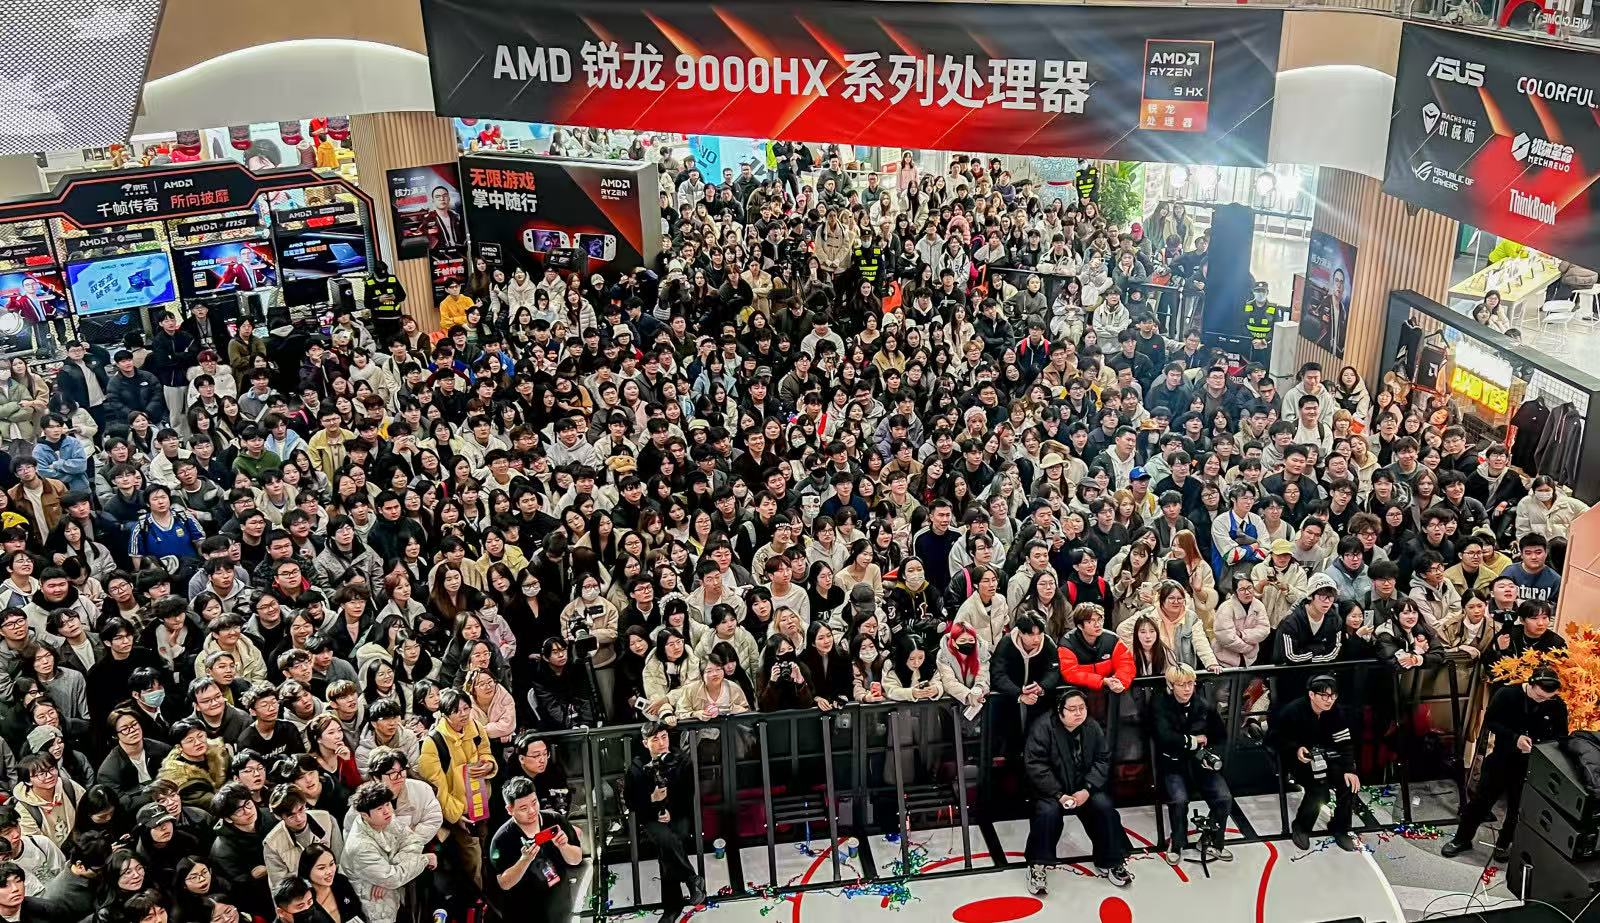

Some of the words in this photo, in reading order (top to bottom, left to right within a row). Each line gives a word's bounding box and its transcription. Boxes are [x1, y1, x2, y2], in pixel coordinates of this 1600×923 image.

[1151, 52, 1186, 65] AMD
[493, 44, 572, 83] AMD
[580, 39, 666, 93] 锐龙
[675, 54, 829, 98] 9000HX
[841, 51, 1091, 115] 系列处理器
[1150, 67, 1193, 77] RYZEN
[1427, 56, 1486, 87] ASUS
[1174, 86, 1183, 96] 9
[1185, 87, 1203, 97] HX
[1439, 120, 1476, 143] 机械师
[1530, 137, 1575, 163] 机械革命
[469, 168, 536, 190] 无限游戏
[600, 178, 622, 188] AMD
[1432, 176, 1459, 191] GAMERS
[1434, 167, 1464, 184] REPUBLIC
[1464, 177, 1475, 185] OF
[164, 180, 186, 189] AMD
[600, 188, 628, 197] RYZEN
[97, 197, 159, 218] 千帧传奇
[170, 189, 229, 209] 所向披靡
[471, 189, 538, 213] 掌中随行
[1509, 188, 1557, 225] ThinkBook
[190, 225, 209, 233] AMD
[225, 219, 246, 228] msi
[79, 238, 100, 247] AMD
